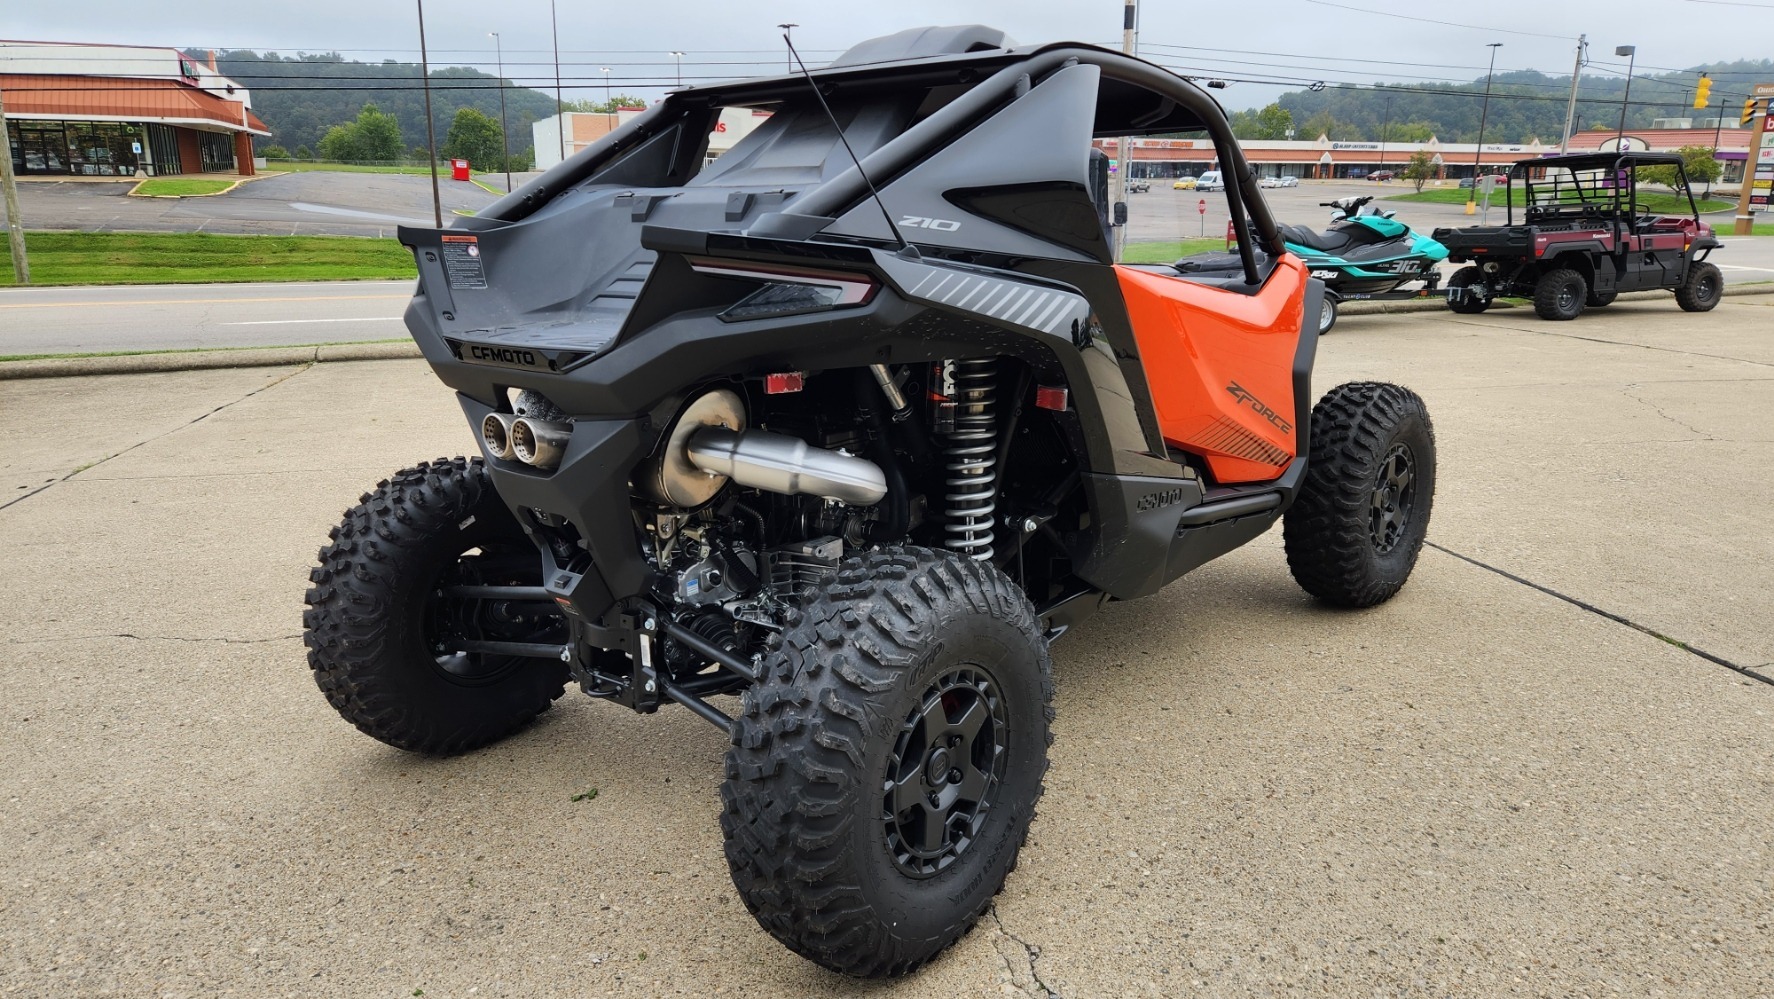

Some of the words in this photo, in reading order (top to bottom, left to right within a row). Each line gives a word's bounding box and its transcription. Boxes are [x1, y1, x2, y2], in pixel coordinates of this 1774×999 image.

[898, 215, 961, 232] Z10
[1388, 260, 1420, 273] 310
[471, 345, 536, 366] CFMOTO
